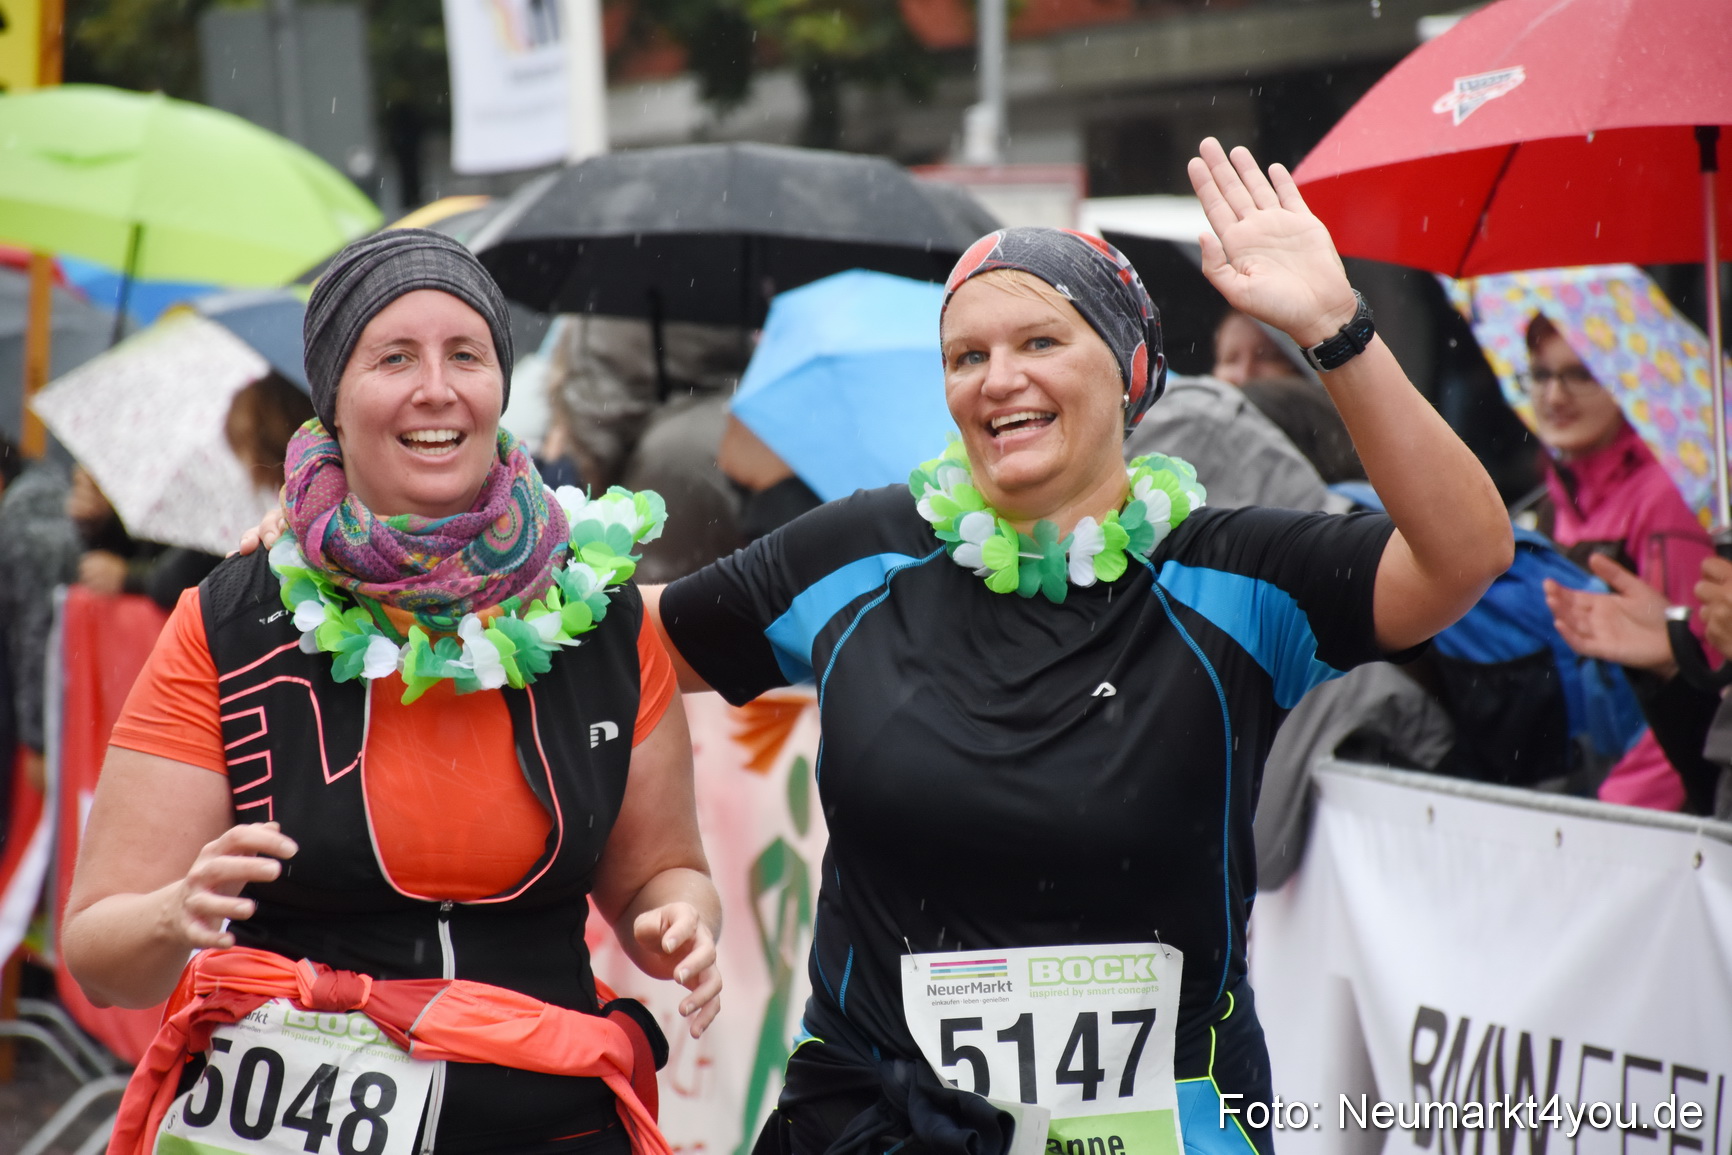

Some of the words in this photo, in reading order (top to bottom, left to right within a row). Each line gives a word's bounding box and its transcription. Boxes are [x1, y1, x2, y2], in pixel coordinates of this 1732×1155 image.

[1028, 954, 1158, 987] BOCK
[927, 980, 1013, 996] NeuerMarkt
[1029, 987, 1069, 999] inspired
[1072, 987, 1084, 998] by
[1087, 985, 1115, 996] smart
[1118, 985, 1159, 996] concepts
[931, 999, 960, 1007] einkaufen
[962, 997, 980, 1005] leben
[243, 1011, 269, 1025] arkt
[281, 1029, 320, 1045] inspired
[322, 1038, 335, 1049] by
[337, 1042, 364, 1055] smart
[366, 1048, 411, 1064] concepts
[939, 1008, 1157, 1105] 5147
[1410, 1004, 1563, 1155] BMW
[183, 1037, 398, 1155] 5048
[1046, 1134, 1126, 1155] anne
